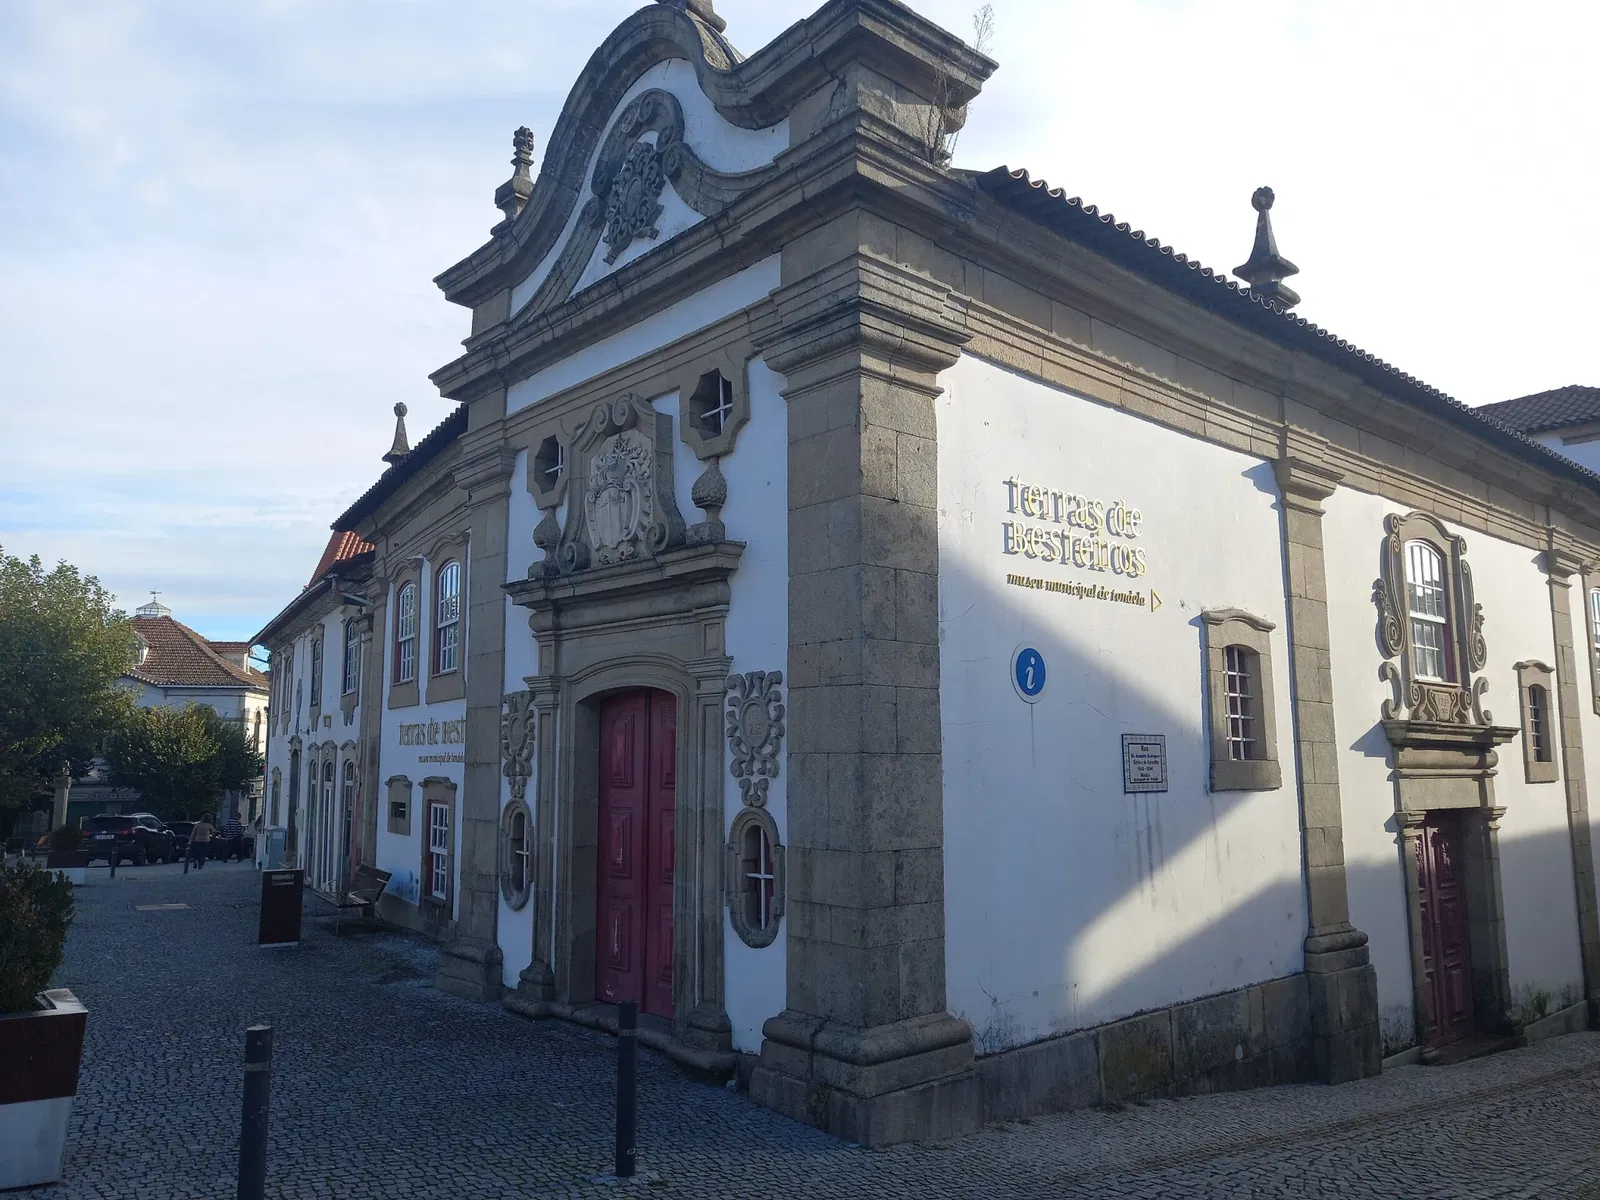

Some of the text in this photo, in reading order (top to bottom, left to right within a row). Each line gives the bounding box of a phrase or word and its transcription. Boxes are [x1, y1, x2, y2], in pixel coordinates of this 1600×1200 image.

[1004, 475, 1143, 539] terras de
[1003, 520, 1147, 578] Besteiros
[1006, 574, 1146, 606] museu municipal de tondela
[399, 721, 426, 746] terras
[427, 718, 440, 745] de
